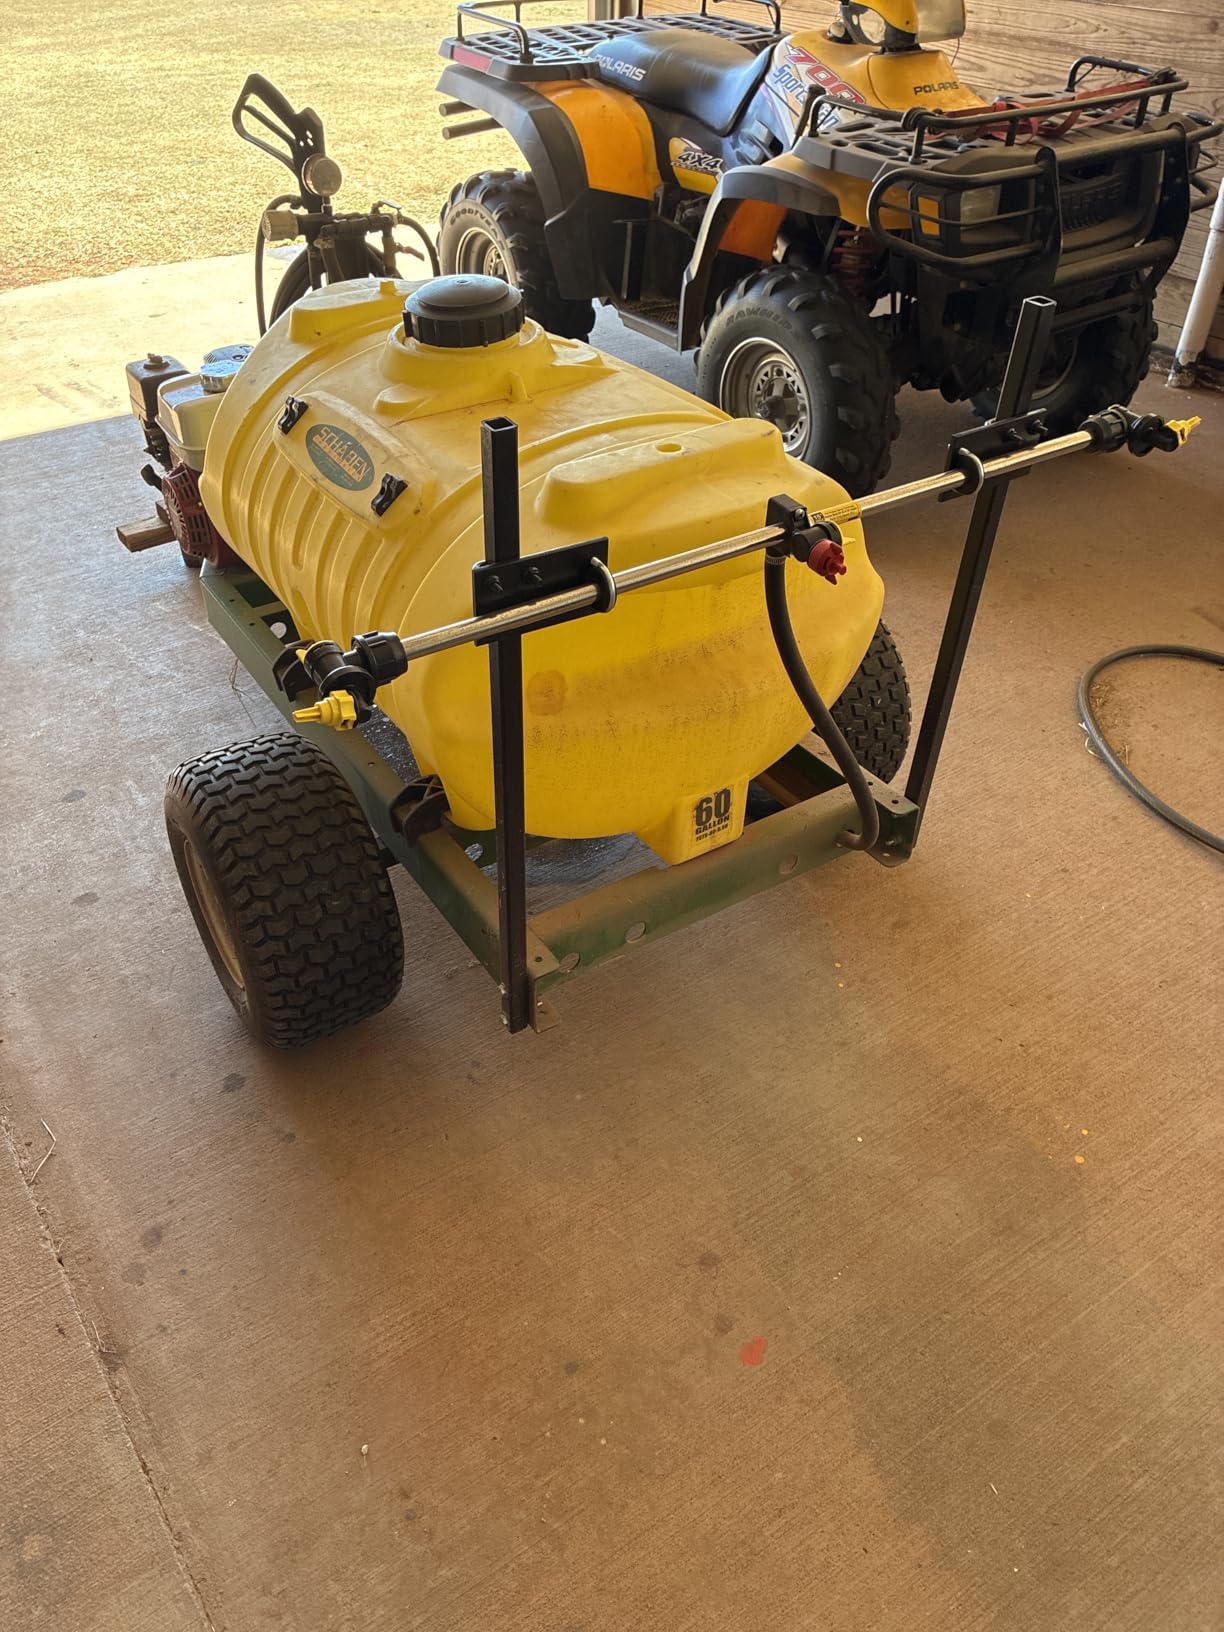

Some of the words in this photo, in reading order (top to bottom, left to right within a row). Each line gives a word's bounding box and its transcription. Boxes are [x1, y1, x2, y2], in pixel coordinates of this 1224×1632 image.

[594, 53, 647, 81] POLARIS
[785, 43, 867, 104] 700
[913, 81, 960, 96] POLARIS
[695, 787, 731, 827] 60
[695, 814, 730, 835] GALLON
